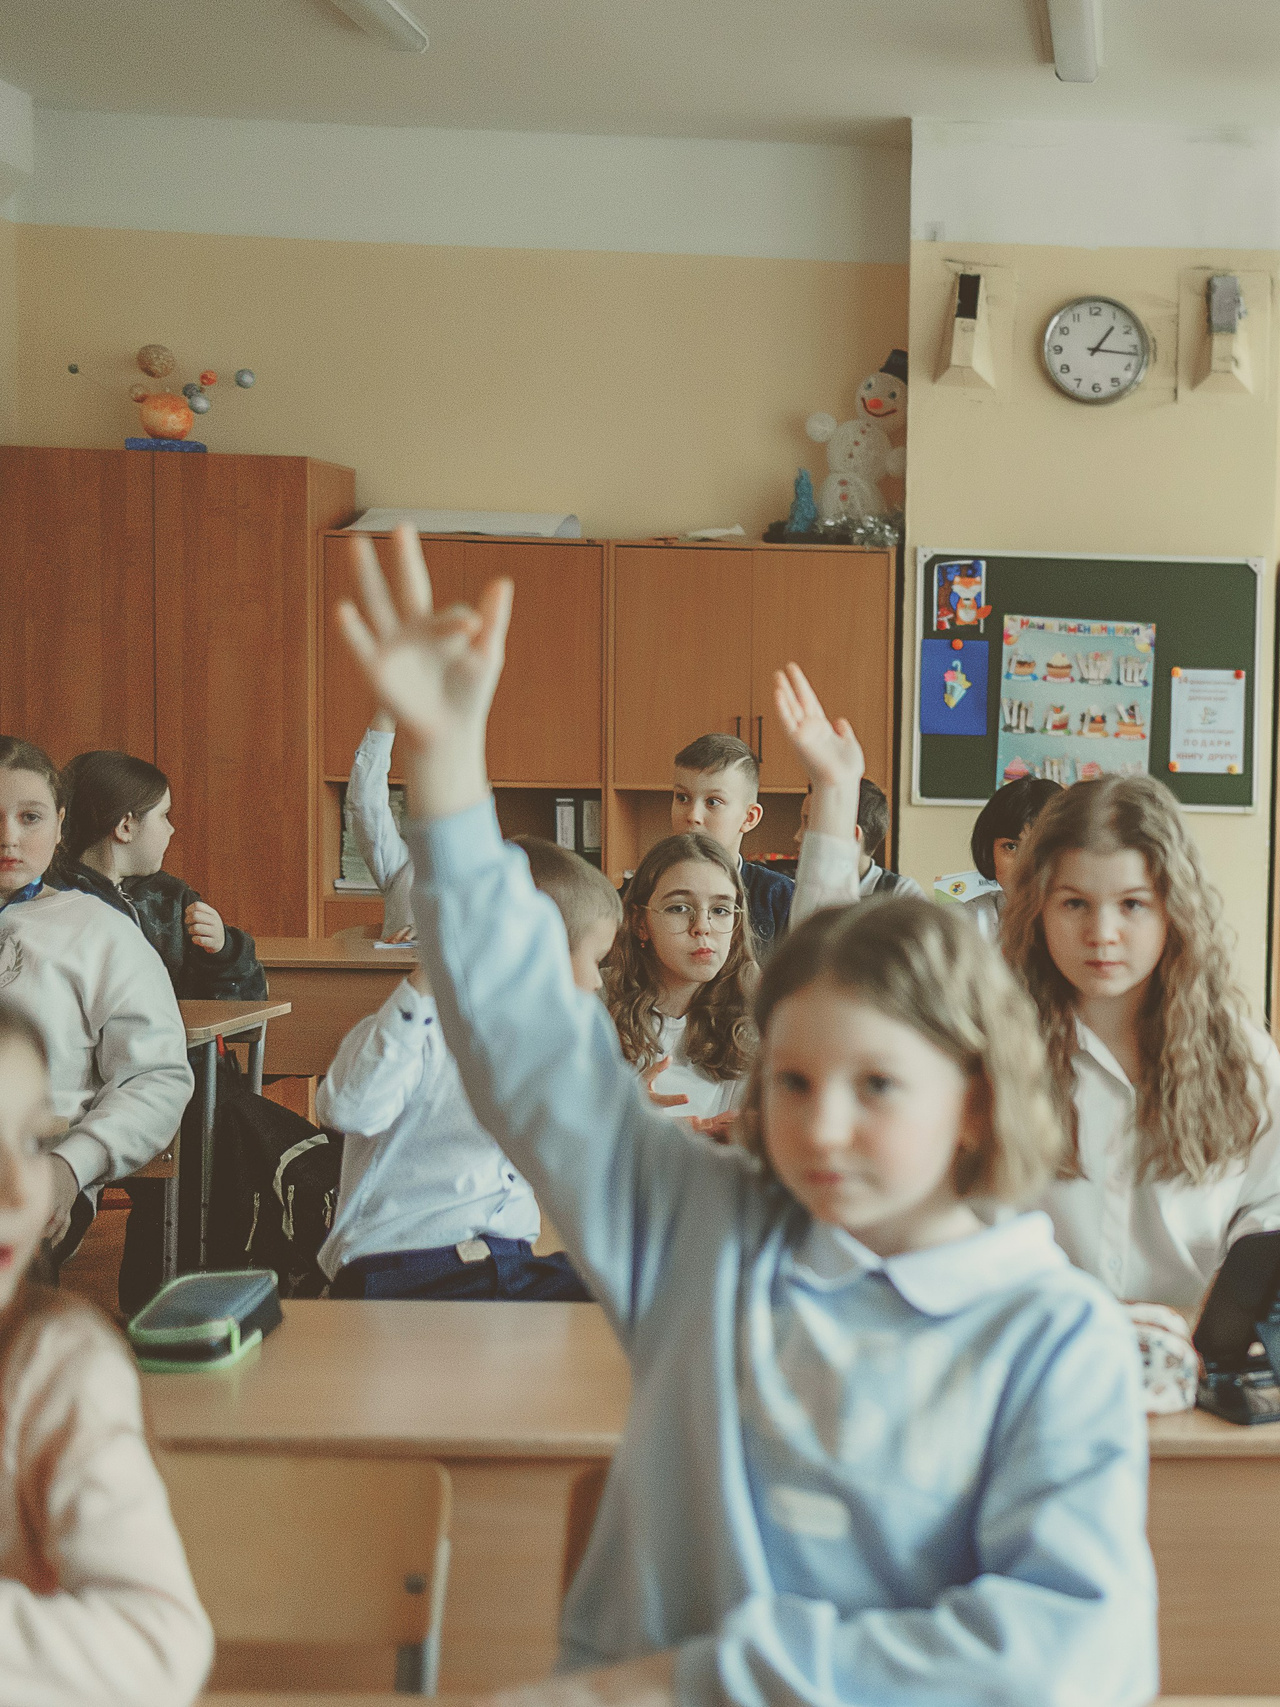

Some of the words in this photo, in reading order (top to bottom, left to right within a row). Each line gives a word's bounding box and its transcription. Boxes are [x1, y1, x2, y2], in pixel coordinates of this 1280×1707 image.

[1089, 306, 1102, 316] 12
[1112, 311, 1117, 321] 1
[1072, 313, 1080, 322] 11
[1059, 326, 1070, 336] 10
[1122, 325, 1132, 335] 2
[1053, 345, 1063, 355] 9
[1129, 344, 1138, 355] 3
[1060, 364, 1070, 374] 8
[1124, 363, 1132, 371] 4
[1073, 378, 1082, 388] 7
[1110, 377, 1121, 387] 5
[1091, 383, 1102, 393] 6
[1183, 739, 1231, 748] ПОДАРИ
